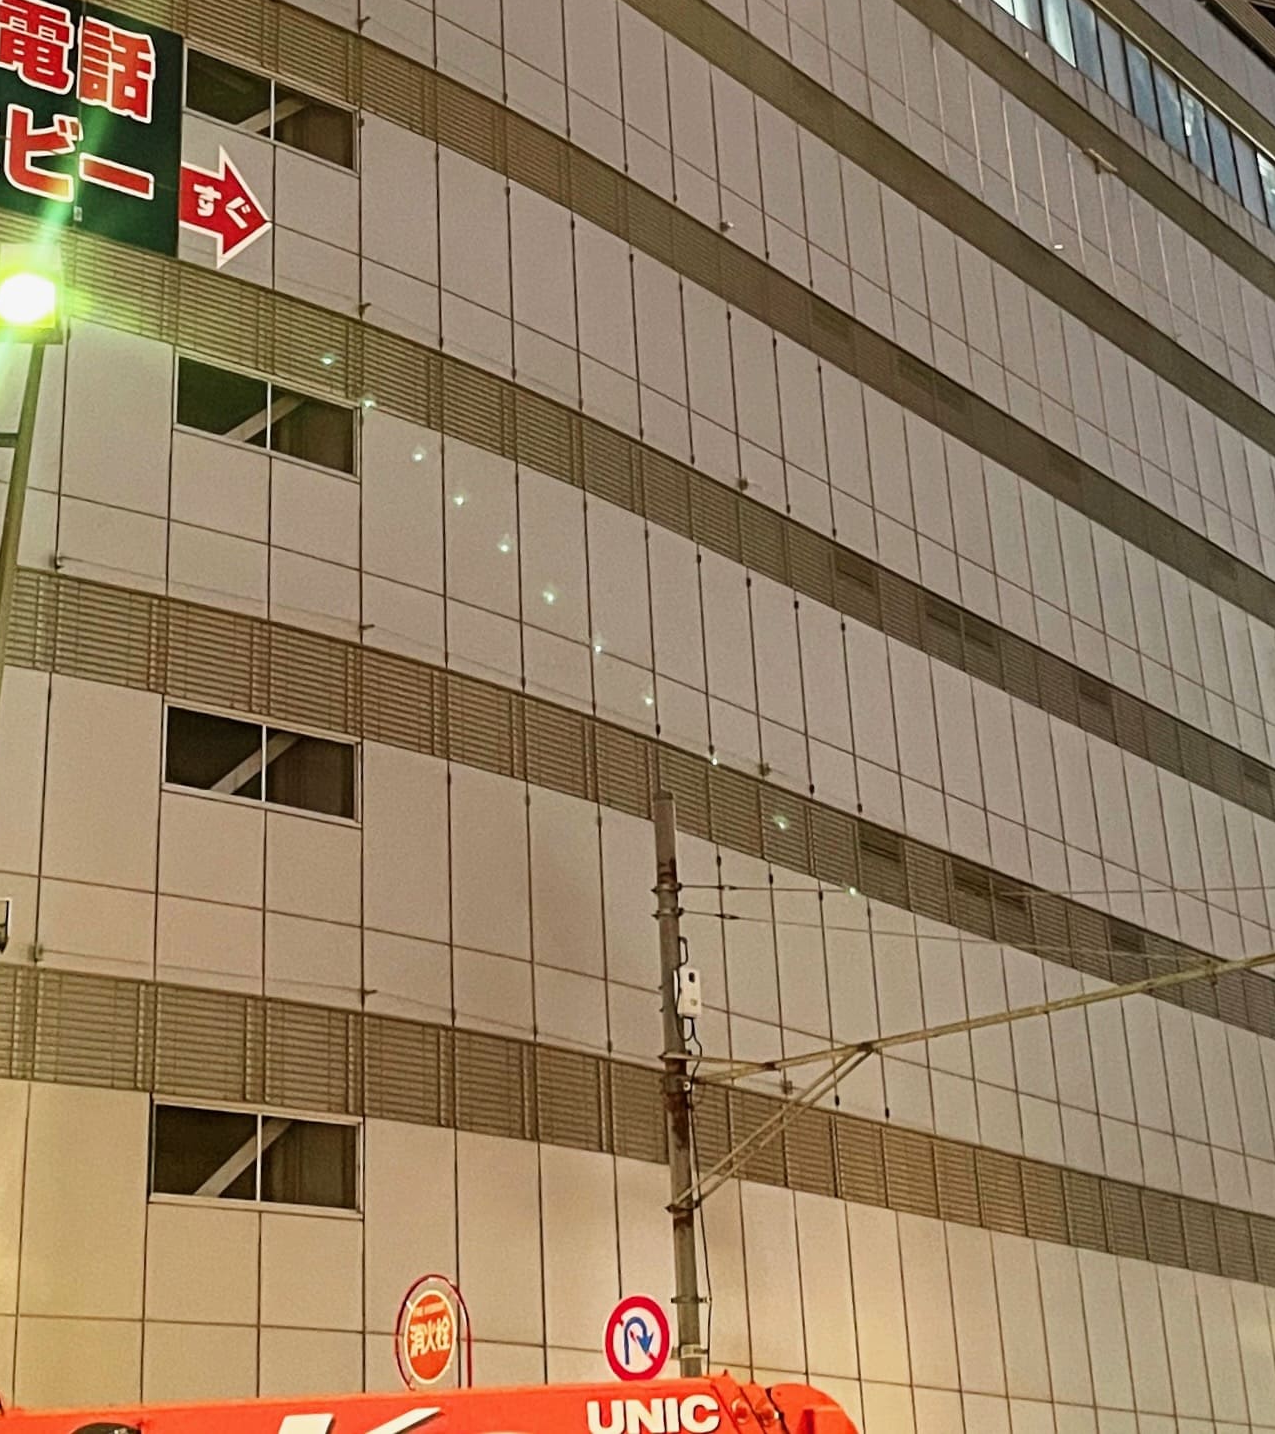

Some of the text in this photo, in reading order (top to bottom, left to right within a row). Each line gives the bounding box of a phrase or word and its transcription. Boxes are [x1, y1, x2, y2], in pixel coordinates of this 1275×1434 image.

[192, 182, 252, 230] すぐ
[409, 1315, 452, 1359] 消火栓
[587, 1394, 721, 1434] UNIC
